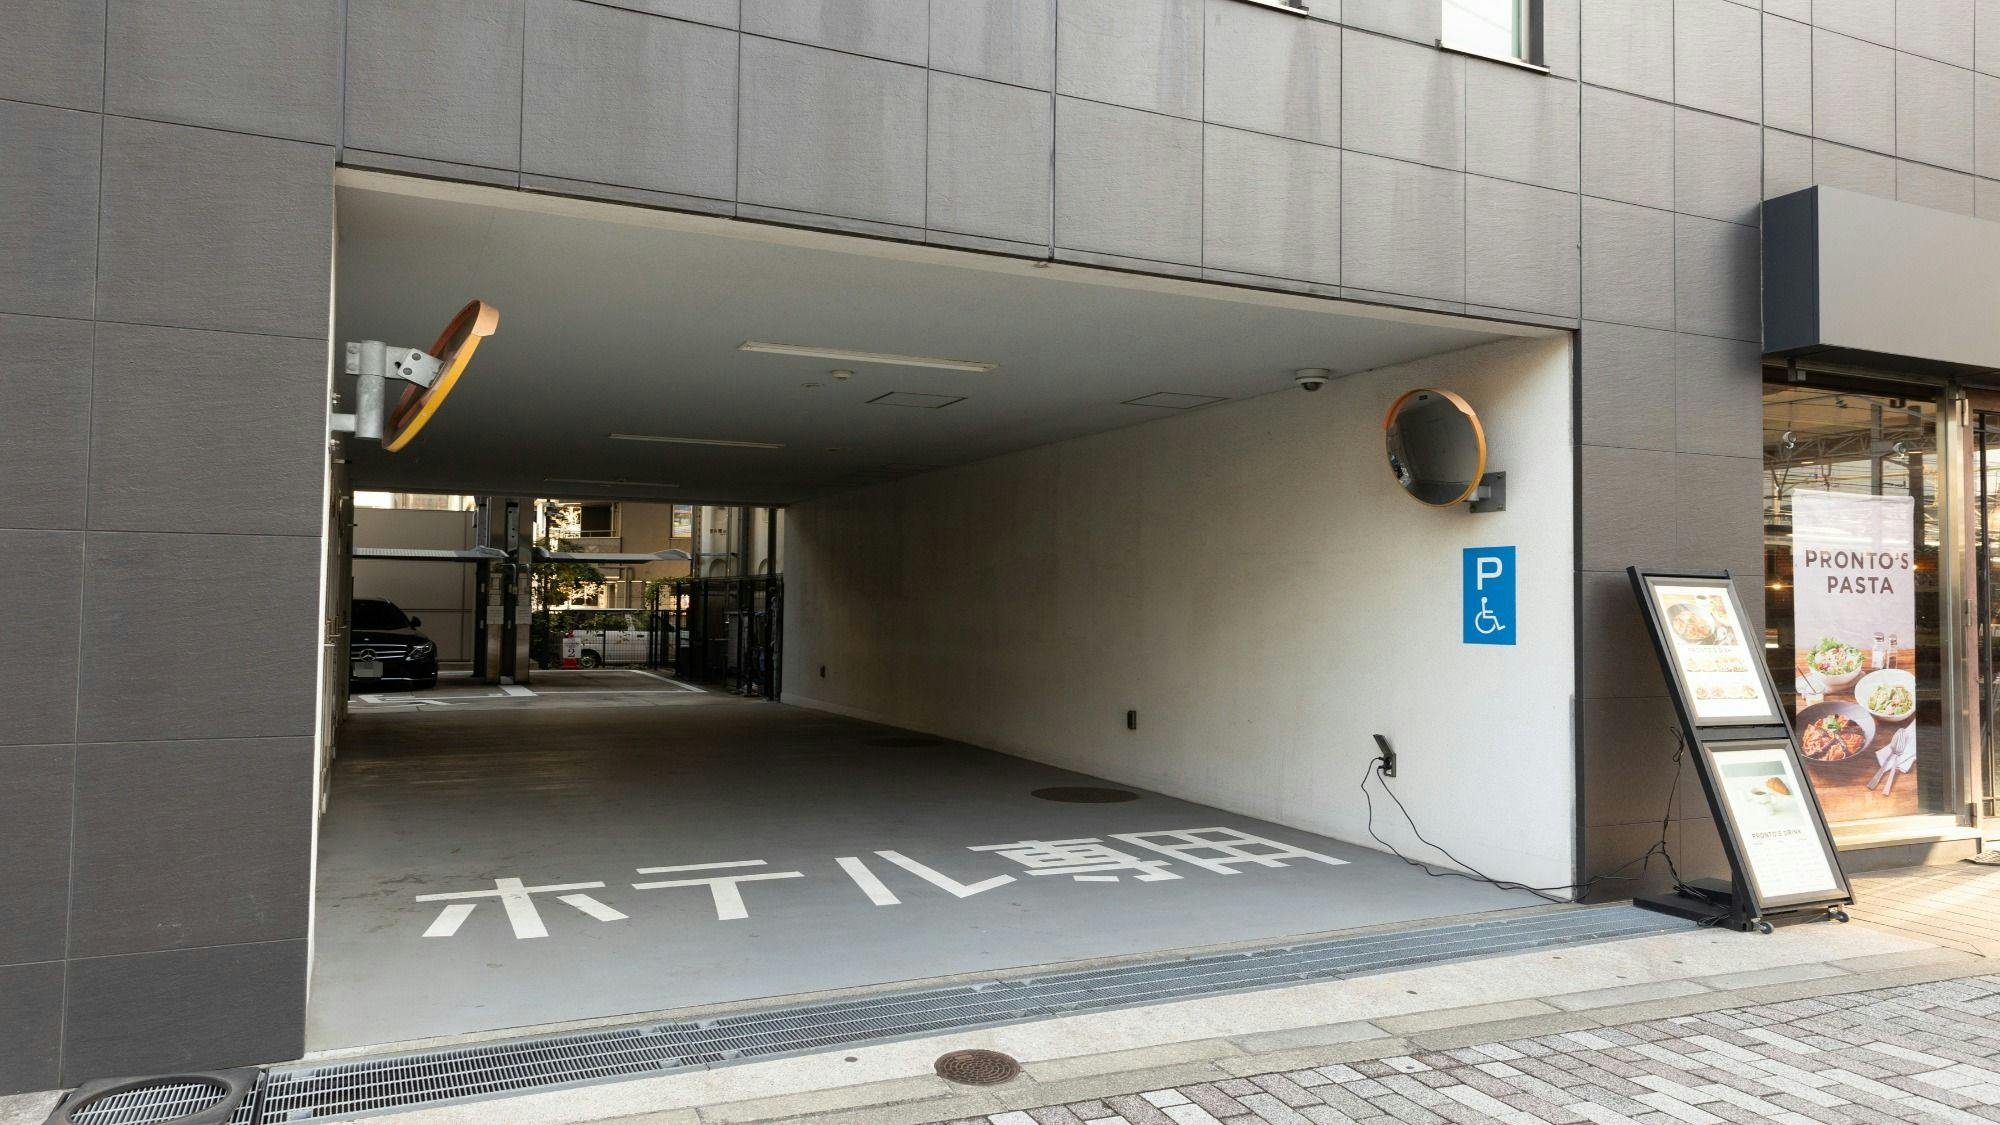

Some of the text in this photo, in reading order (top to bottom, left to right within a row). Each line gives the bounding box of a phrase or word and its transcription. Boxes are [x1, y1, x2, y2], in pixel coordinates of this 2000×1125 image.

[1477, 556, 1503, 590] P
[1805, 549, 1909, 570] PRONTO'S
[1827, 575, 1894, 595] PASTA
[415, 826, 1351, 941] ホテル専用
